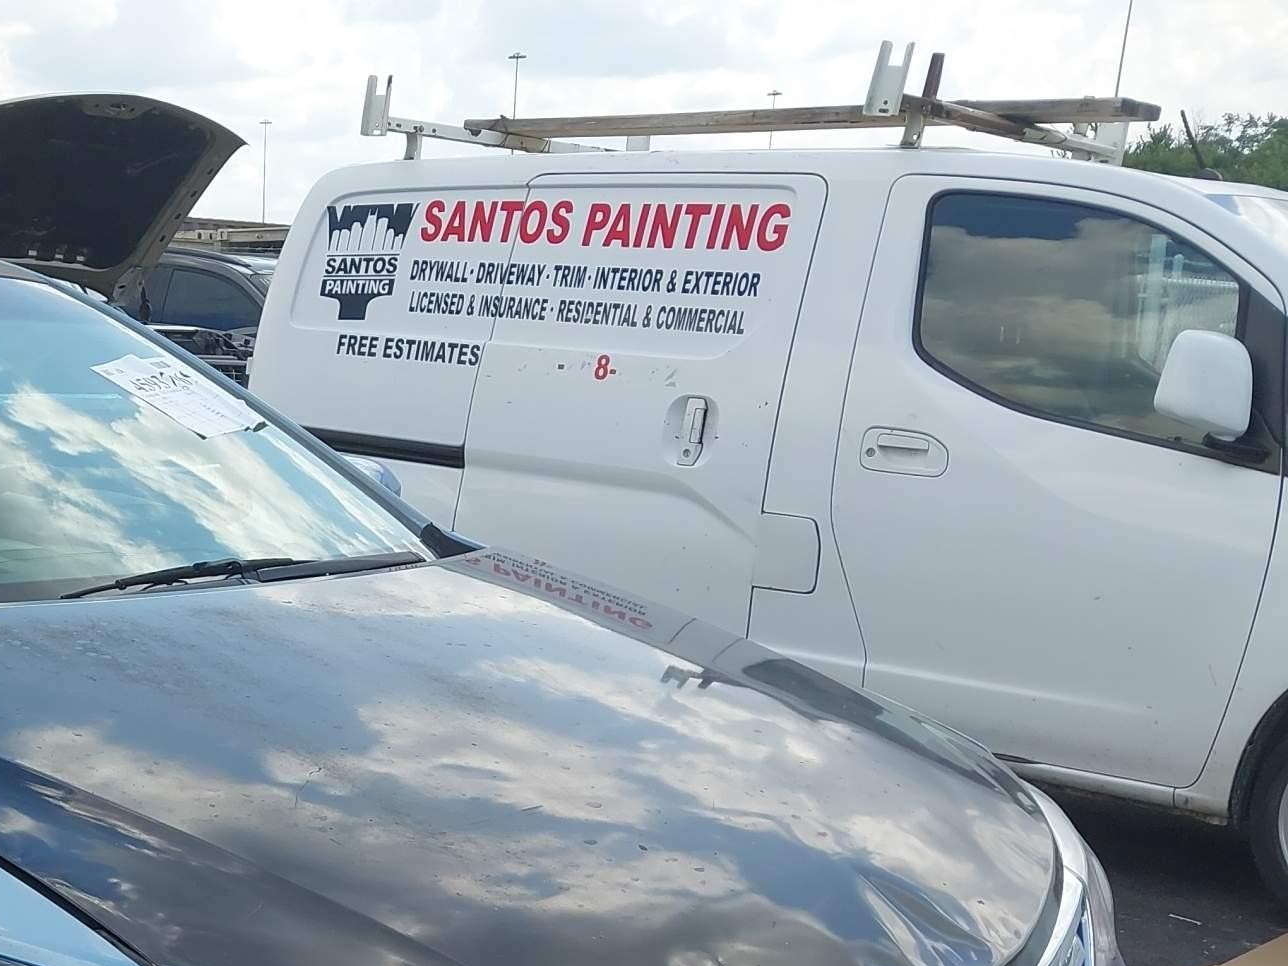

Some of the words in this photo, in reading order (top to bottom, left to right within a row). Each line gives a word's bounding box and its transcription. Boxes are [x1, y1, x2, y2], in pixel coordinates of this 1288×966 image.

[420, 200, 574, 244] SANTOS
[581, 202, 792, 251] PAINTING
[324, 256, 399, 275] SANTOS
[409, 259, 468, 283] DRYWALL
[475, 262, 546, 286] DRIVEWAY
[552, 264, 588, 289] TRIM
[592, 266, 664, 292] INTERIOR
[666, 269, 678, 294] &
[681, 270, 762, 297] EXTERIOR
[324, 279, 390, 295] PAINTING
[408, 290, 465, 316] LICENSED
[466, 293, 476, 316] &
[477, 294, 549, 321] INSURANCE
[556, 299, 638, 327] RESIDENTIAL
[642, 304, 653, 329] &
[655, 305, 745, 335] COMMERCIAL
[336, 334, 379, 357] FREE
[382, 338, 481, 366] ESTIMATES
